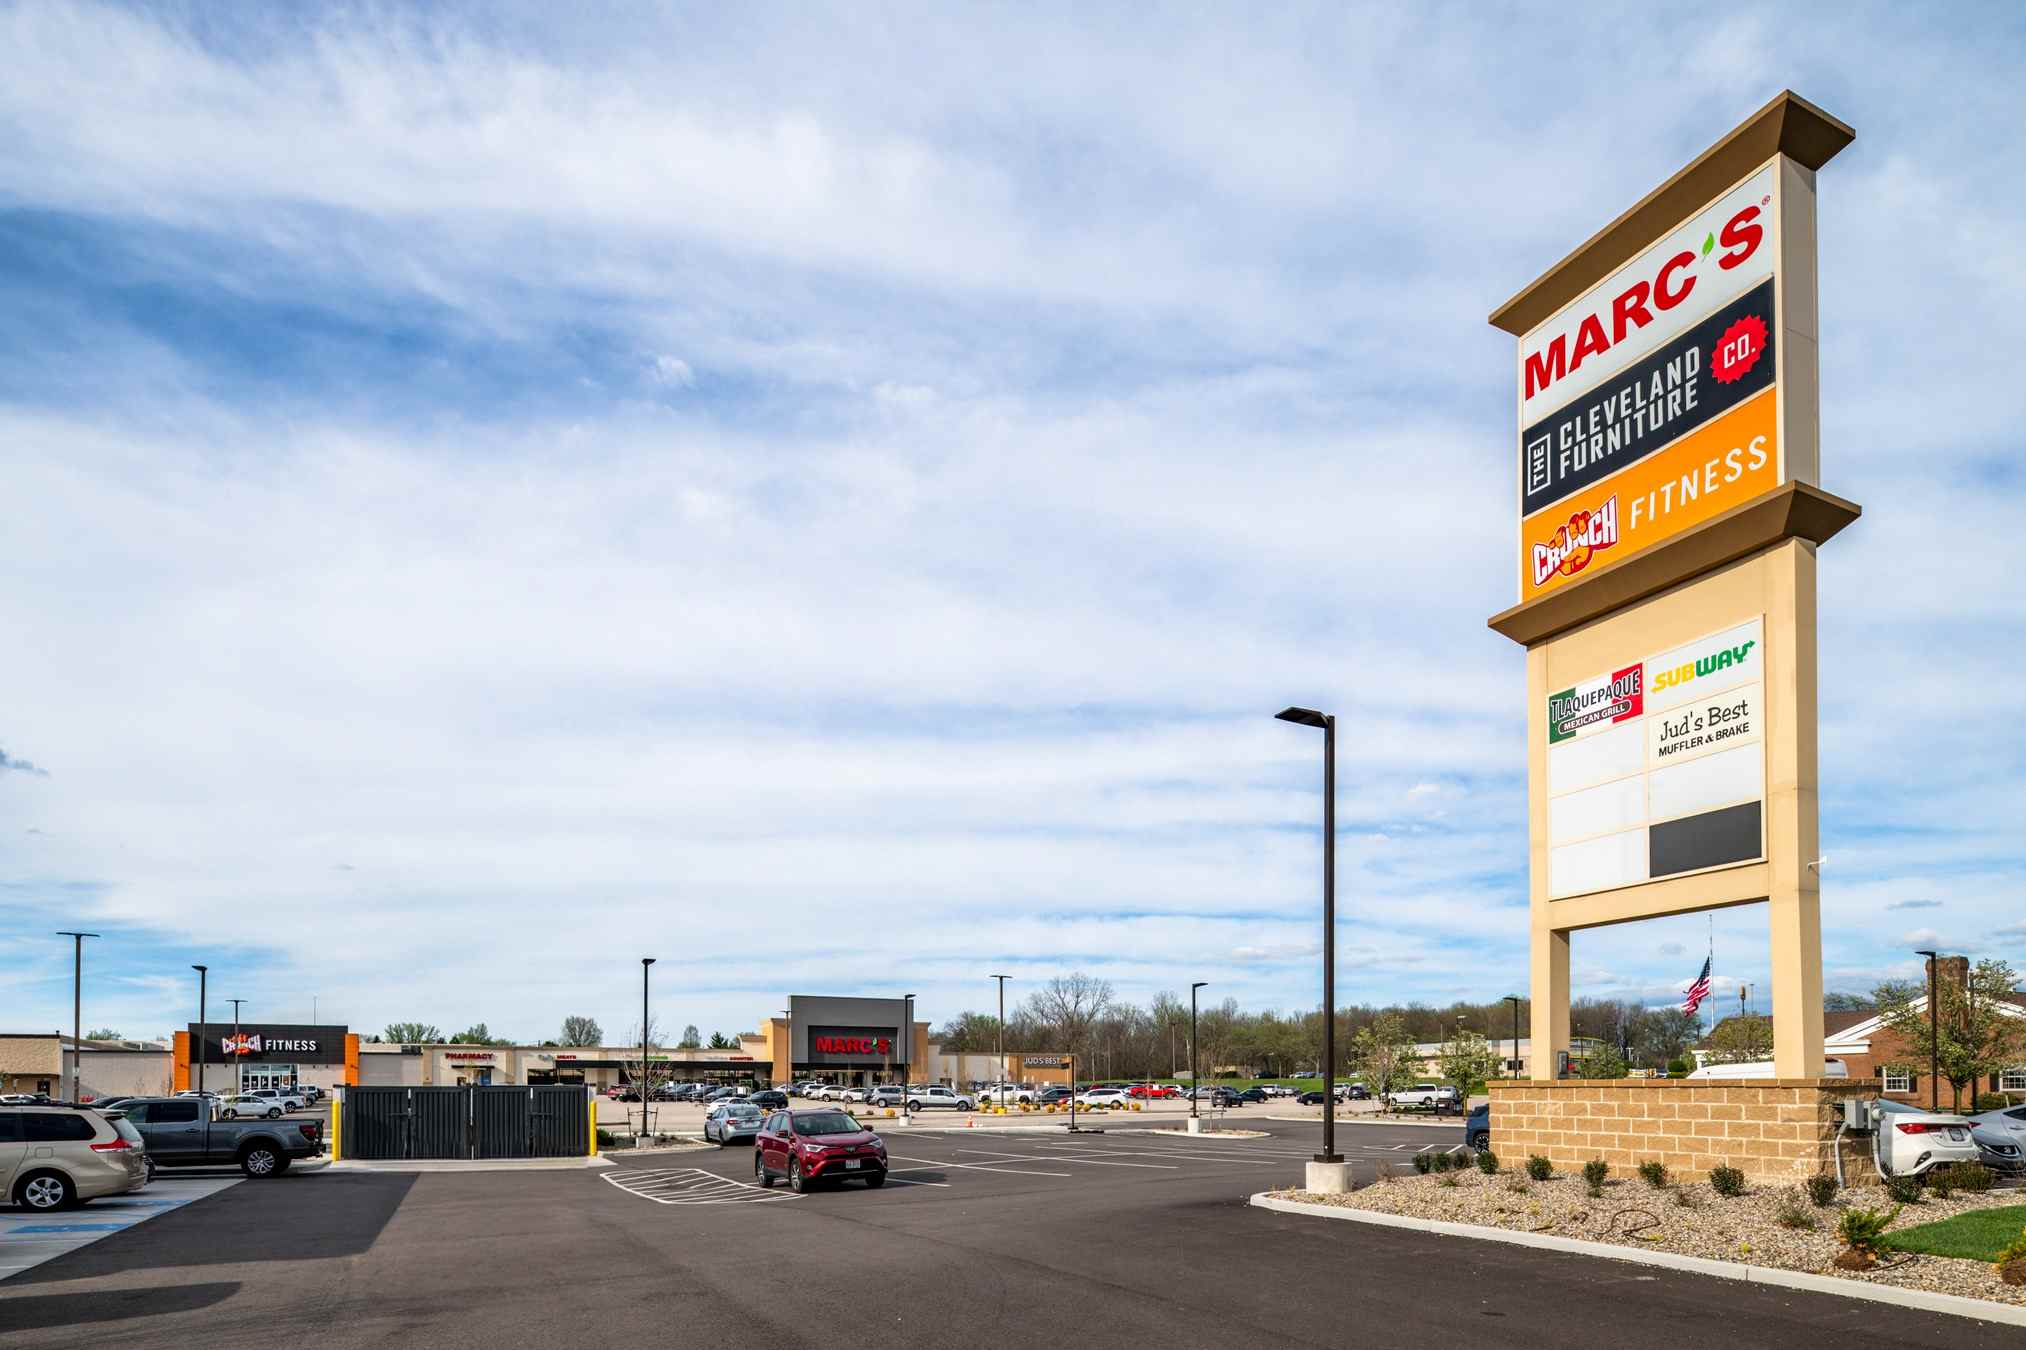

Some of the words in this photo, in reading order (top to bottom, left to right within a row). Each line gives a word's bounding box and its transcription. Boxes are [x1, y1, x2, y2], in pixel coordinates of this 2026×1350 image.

[1525, 205, 1763, 401] MARC'S
[1723, 333, 1756, 369] CO.
[1559, 346, 1700, 451] CLEVELAND
[1559, 377, 1698, 480] FURNITURE
[1533, 444, 1545, 486] THE
[1532, 494, 1618, 586] CRUNCH
[1630, 435, 1768, 530] FITNESS
[1651, 640, 1755, 694] SUBWAY
[1551, 670, 1640, 722] TLAQUEPAQUE
[1563, 713, 1600, 731] MEXICAN
[1601, 704, 1626, 719] GRILL
[1658, 736, 1704, 757] MUFFLER
[1705, 734, 1714, 743] &
[1715, 722, 1750, 741] BRAKE
[1660, 711, 1703, 742] Jud's
[1707, 699, 1749, 727] Best
[265, 1039, 317, 1051] FITNESS
[816, 1036, 889, 1055] MARC'S
